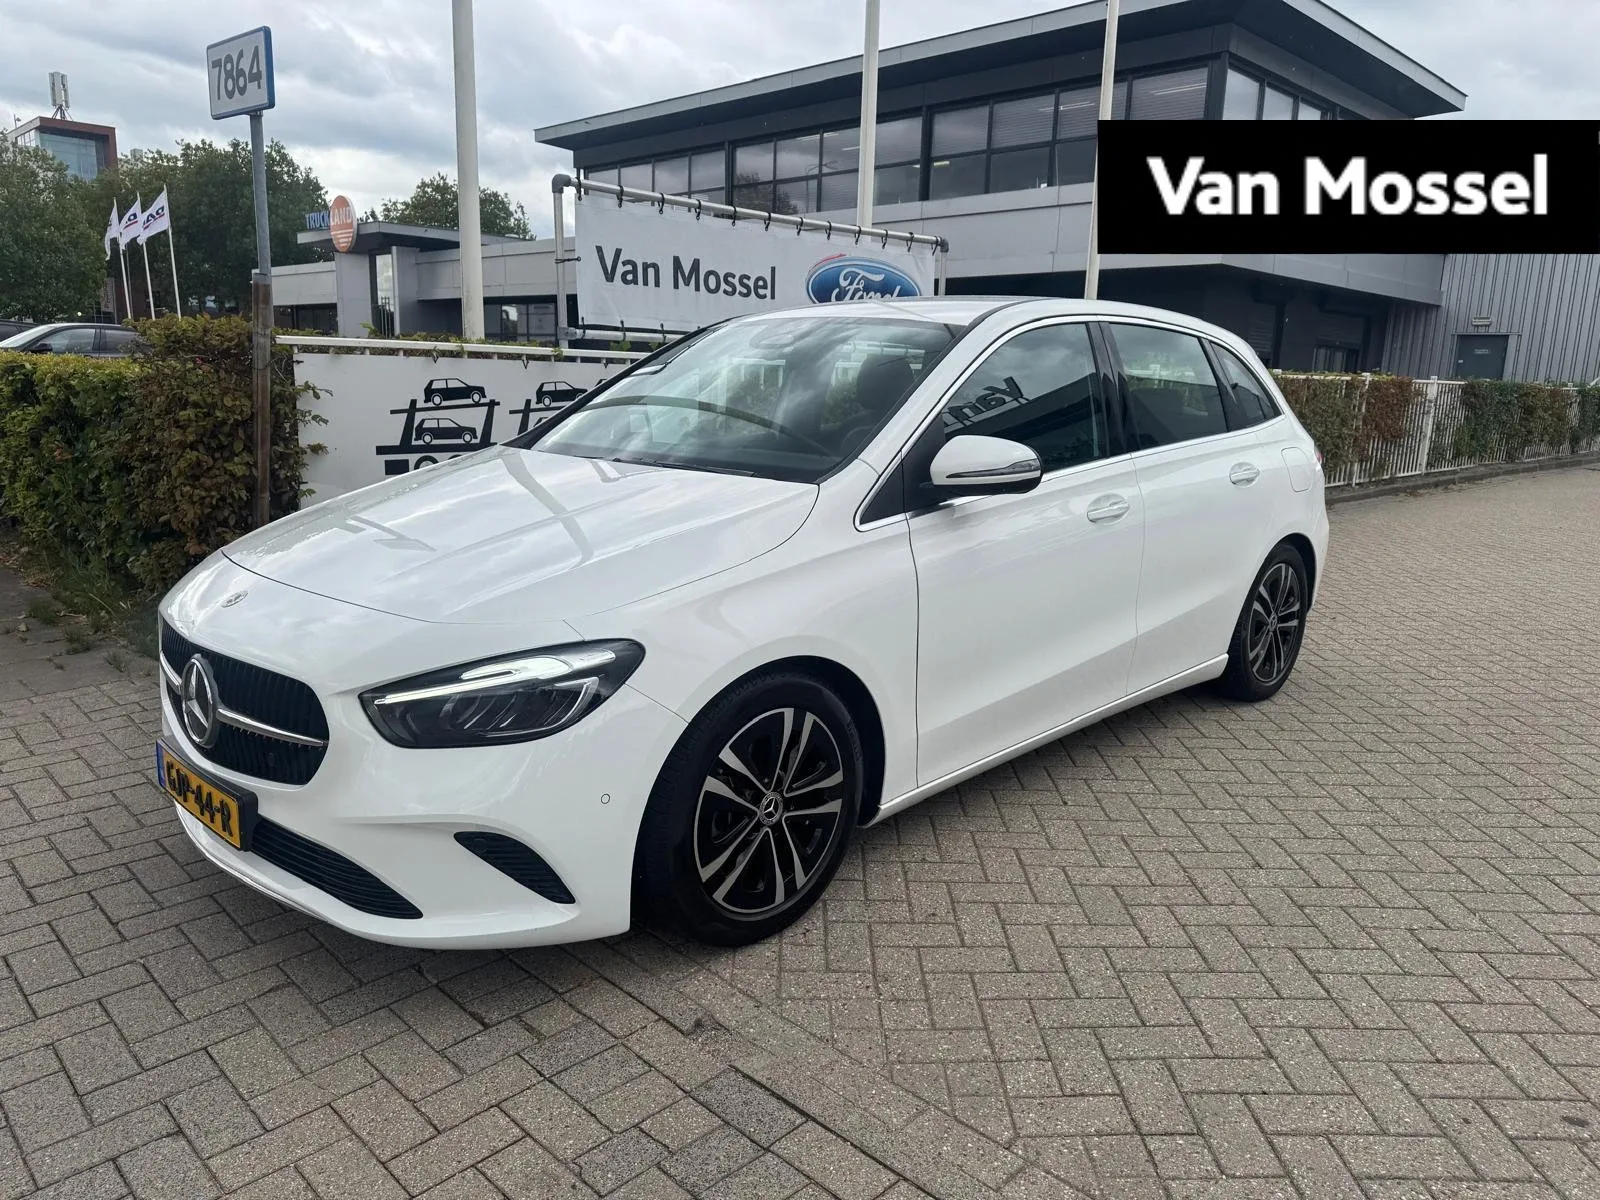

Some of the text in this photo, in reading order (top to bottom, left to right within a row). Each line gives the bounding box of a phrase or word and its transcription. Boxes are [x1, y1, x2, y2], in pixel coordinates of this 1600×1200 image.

[211, 45, 262, 101] 7864
[595, 245, 776, 300] Van Mossel
[830, 267, 900, 302] Ford
